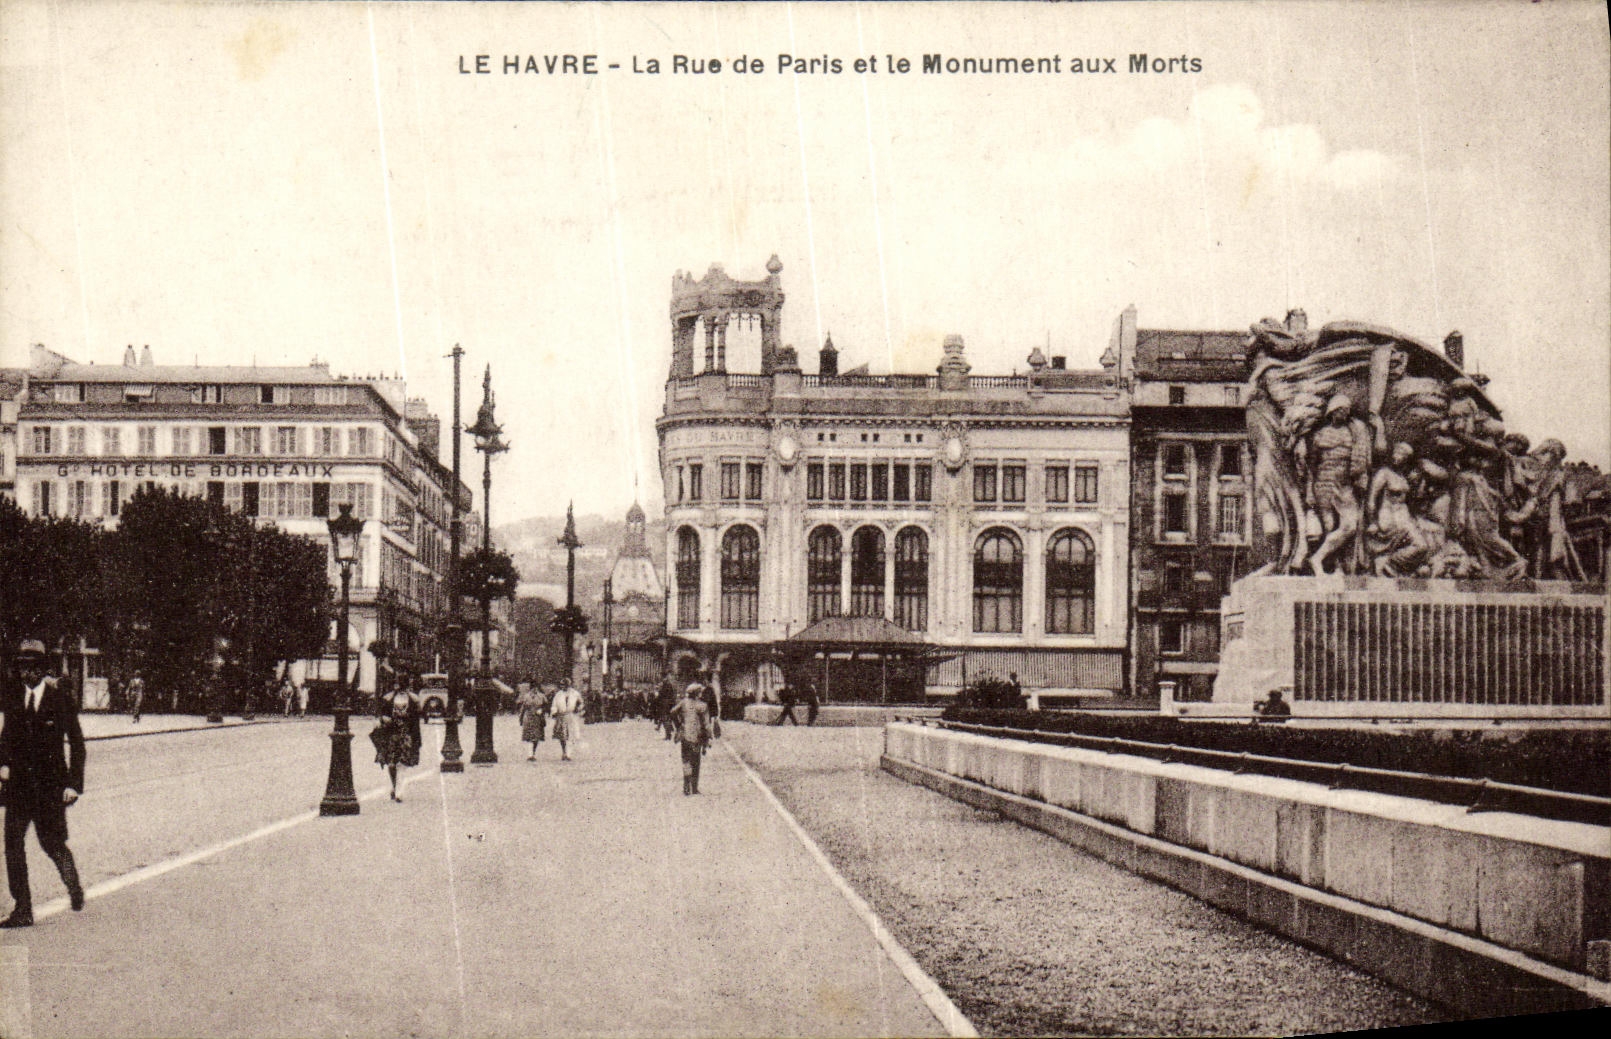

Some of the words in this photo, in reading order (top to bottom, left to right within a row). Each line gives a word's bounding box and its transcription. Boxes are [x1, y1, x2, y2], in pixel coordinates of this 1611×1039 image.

[91, 464, 158, 477] HOTEL
[171, 464, 196, 477] DE
[210, 464, 333, 478] BORDEAUX
